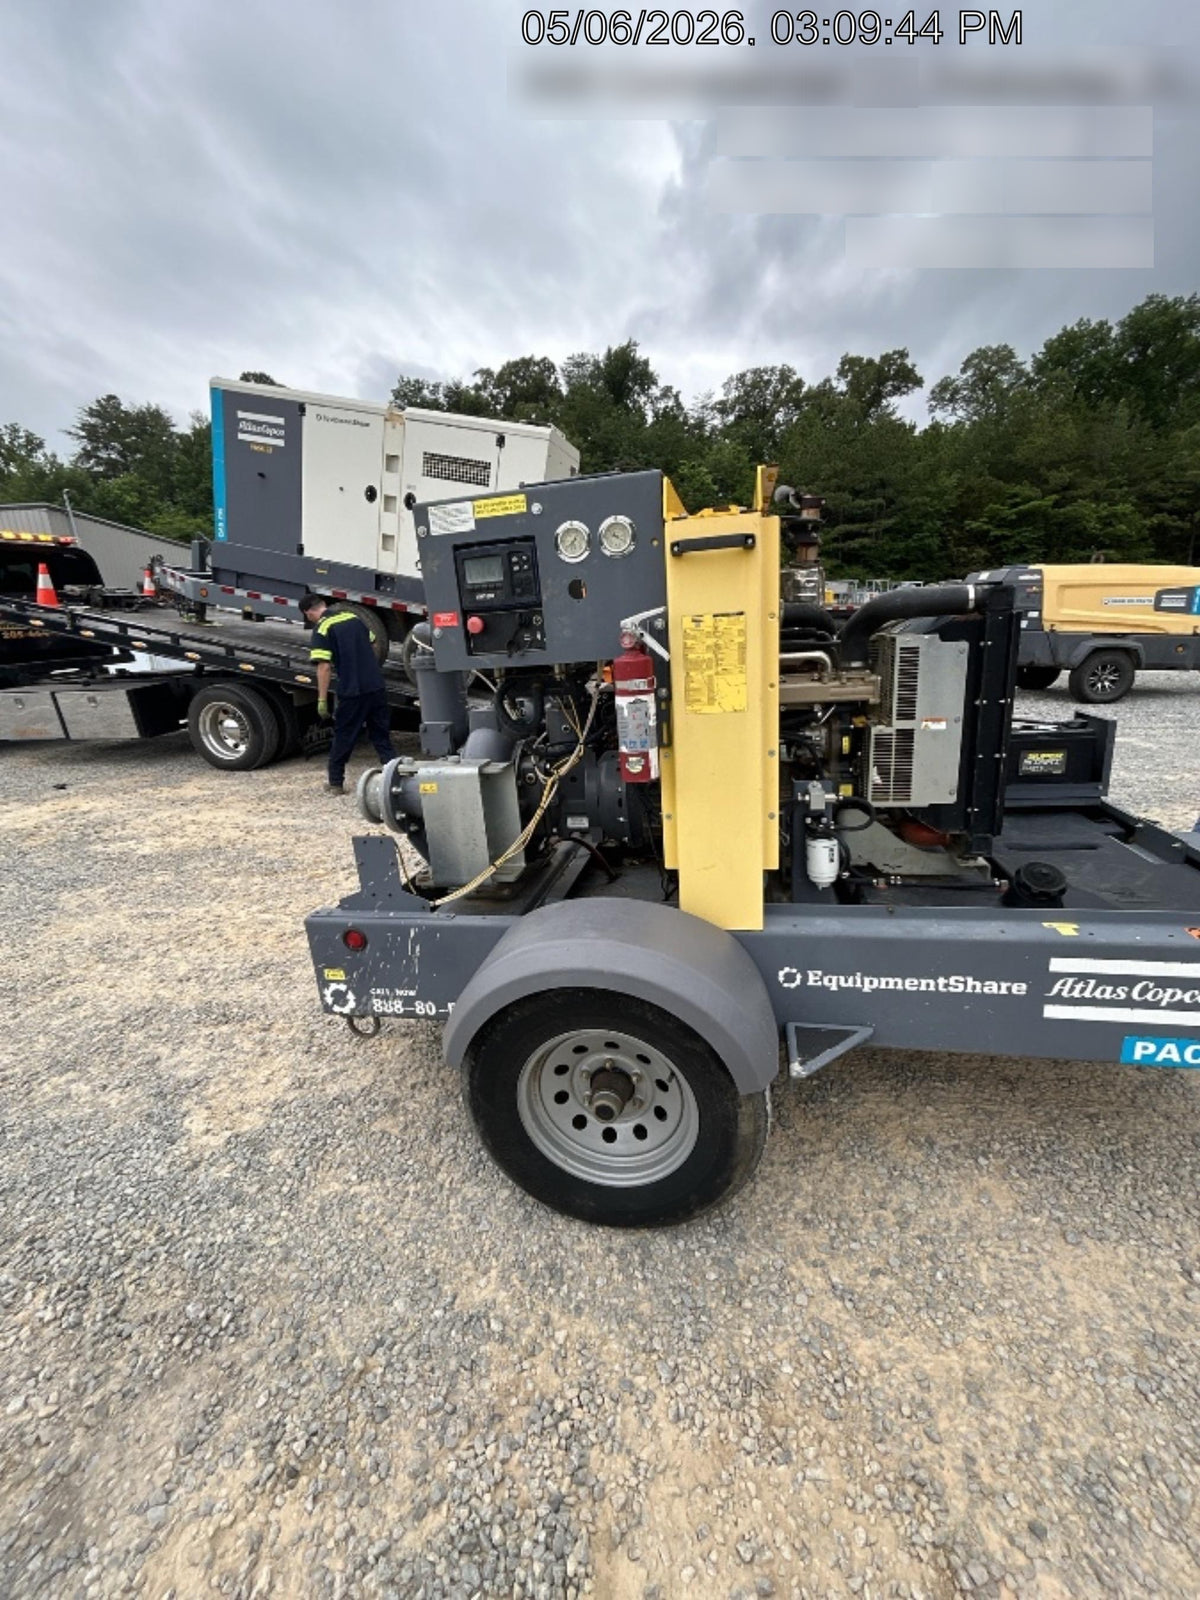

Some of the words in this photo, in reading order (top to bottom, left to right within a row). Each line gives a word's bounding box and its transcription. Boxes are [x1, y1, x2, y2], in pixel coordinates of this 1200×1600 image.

[395, 988, 417, 997] NOW
[806, 969, 1028, 996] EquipmentShare
[1043, 976, 1130, 1000] Atlas
[1131, 980, 1200, 1007] Copc
